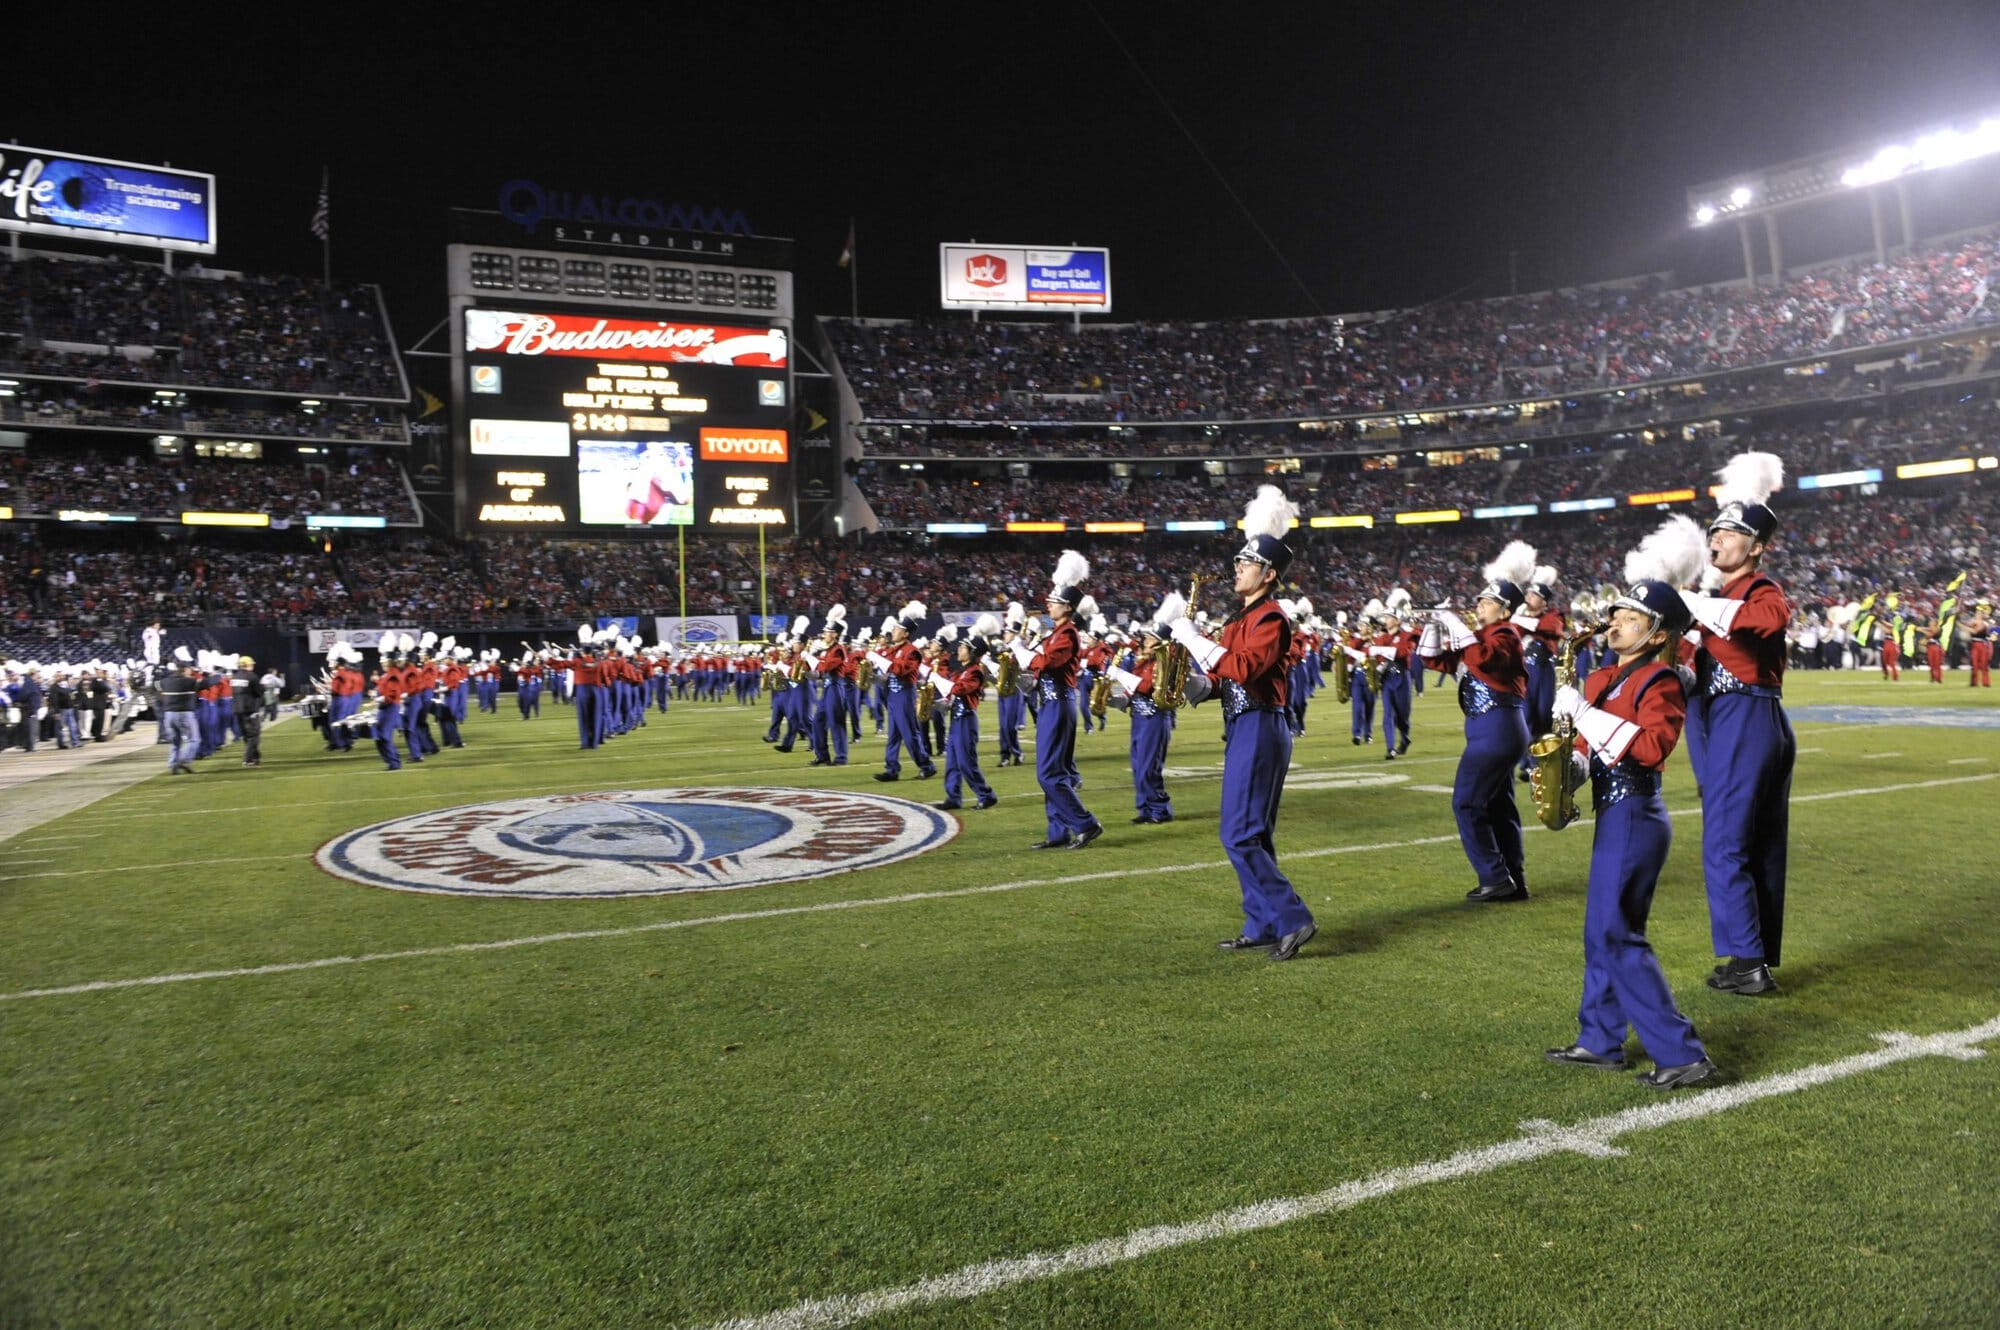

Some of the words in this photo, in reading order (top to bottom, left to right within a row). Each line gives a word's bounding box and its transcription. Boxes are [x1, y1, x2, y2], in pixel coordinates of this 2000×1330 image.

[0, 153, 55, 218] ife
[103, 178, 202, 204] Transforming
[126, 194, 181, 210] science
[499, 179, 752, 235] QUALCOMM
[554, 226, 734, 253] STADIUM
[500, 314, 715, 355] Budweiser
[705, 437, 784, 456] TOYOTA
